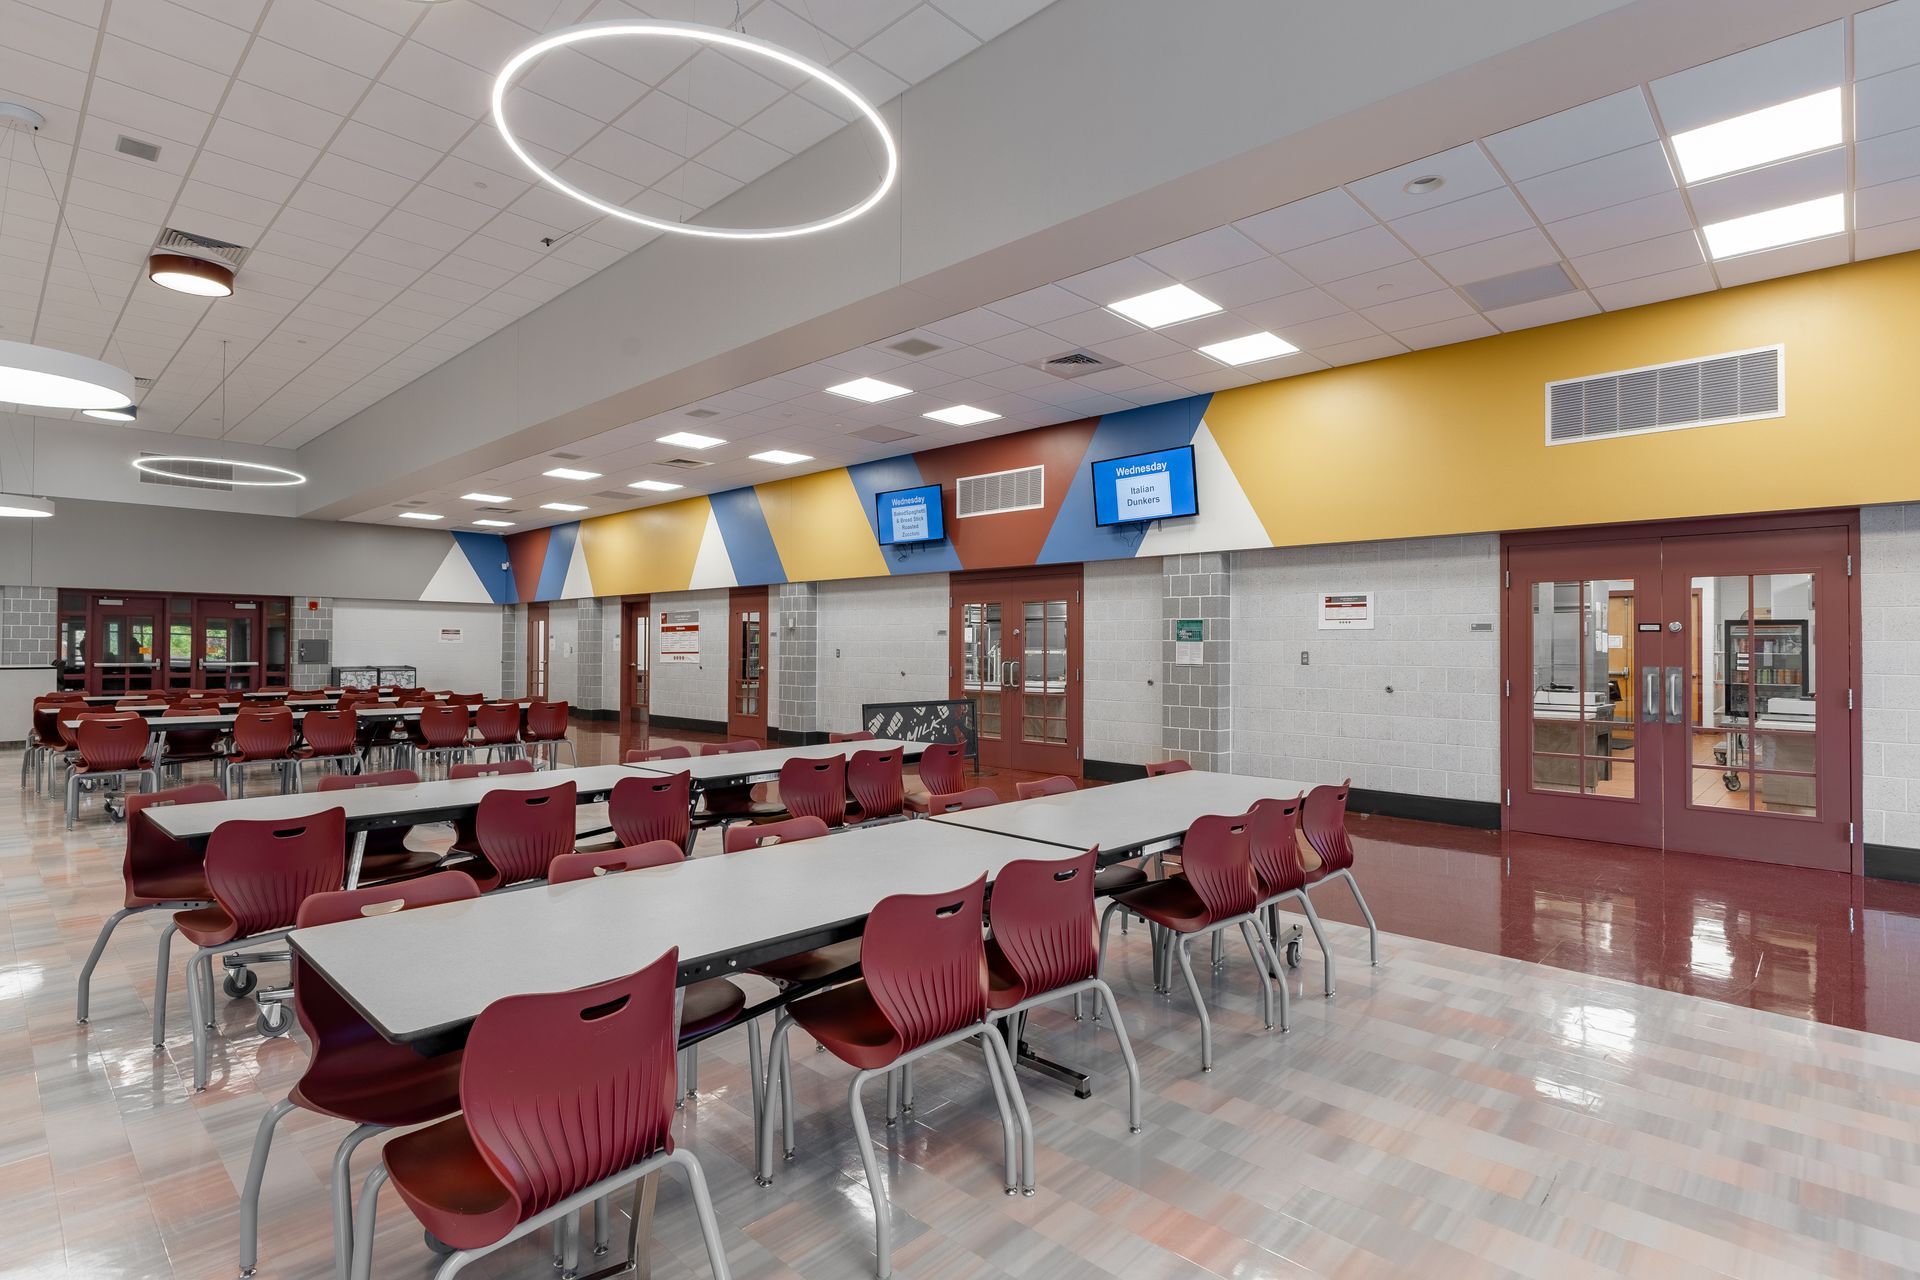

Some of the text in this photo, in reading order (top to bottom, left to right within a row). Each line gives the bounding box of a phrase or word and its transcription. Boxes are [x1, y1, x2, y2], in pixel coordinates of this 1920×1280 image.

[1116, 461, 1167, 477] Wednesday
[1130, 485, 1155, 495] Italian
[891, 496, 925, 506] Wednesday
[1127, 496, 1160, 507] Dunkers
[906, 718, 941, 741] MILK
